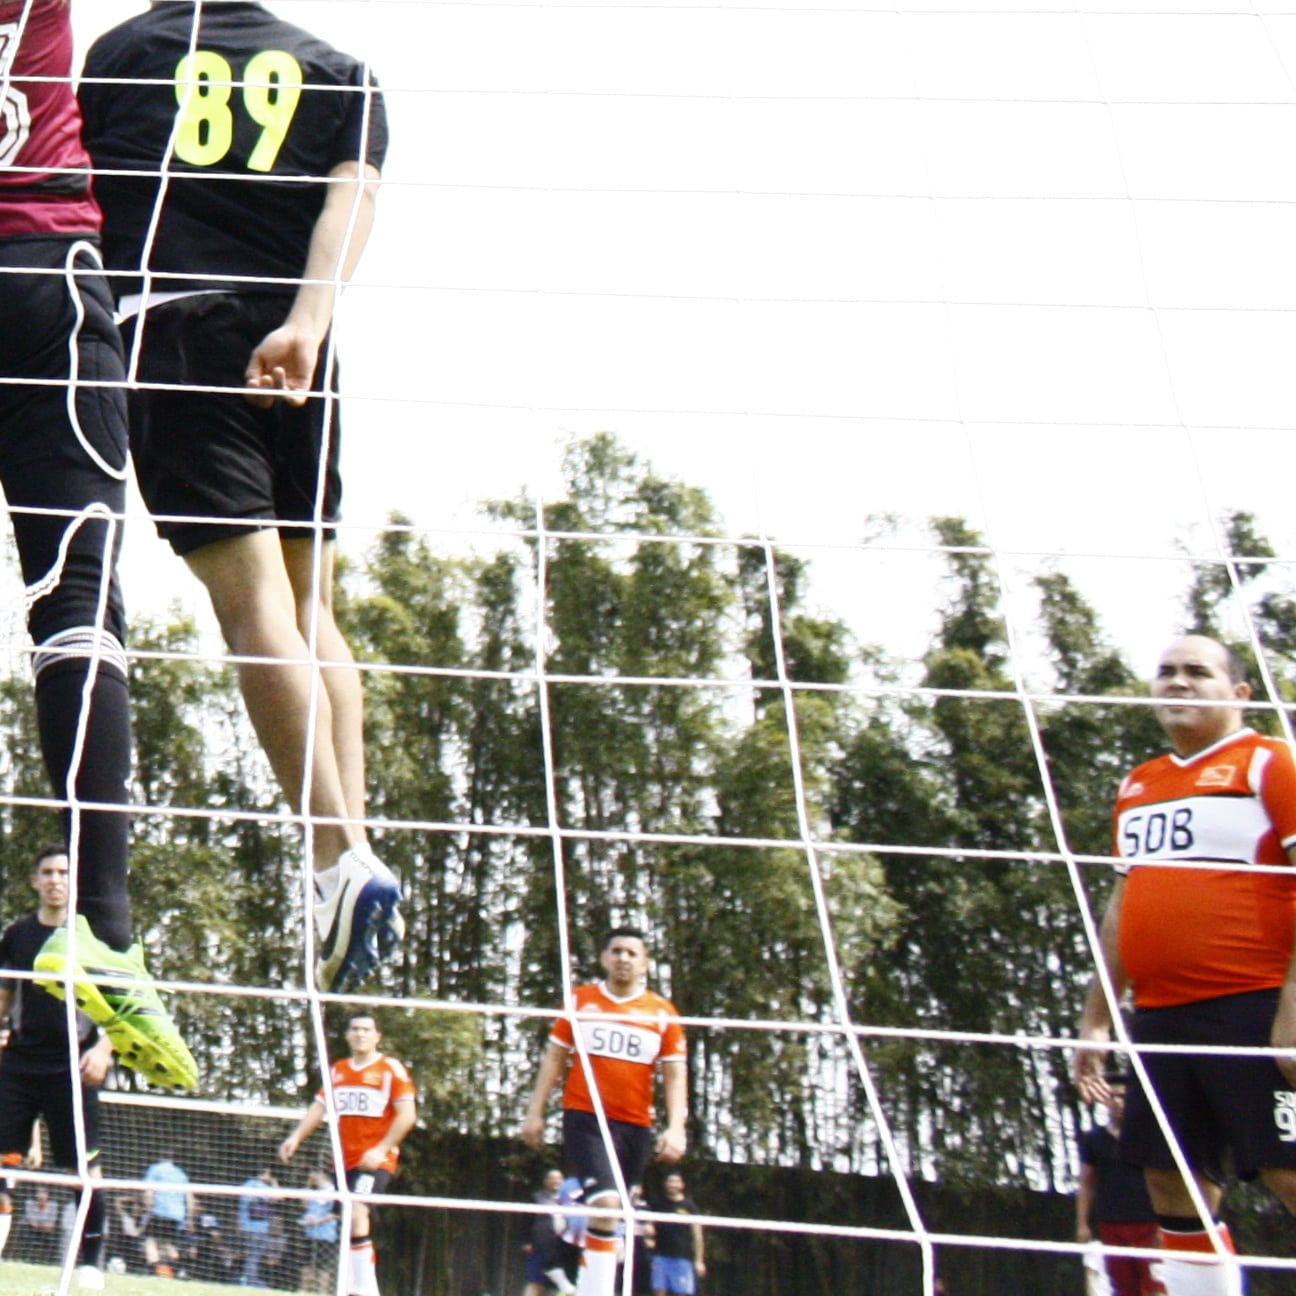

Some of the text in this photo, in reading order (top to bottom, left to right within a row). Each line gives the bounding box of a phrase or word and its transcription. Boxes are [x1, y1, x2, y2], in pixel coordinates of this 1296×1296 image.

[174, 49, 303, 172] 89
[1124, 807, 1194, 857] SDB
[592, 1026, 642, 1058] SDB
[337, 1090, 369, 1113] SDB
